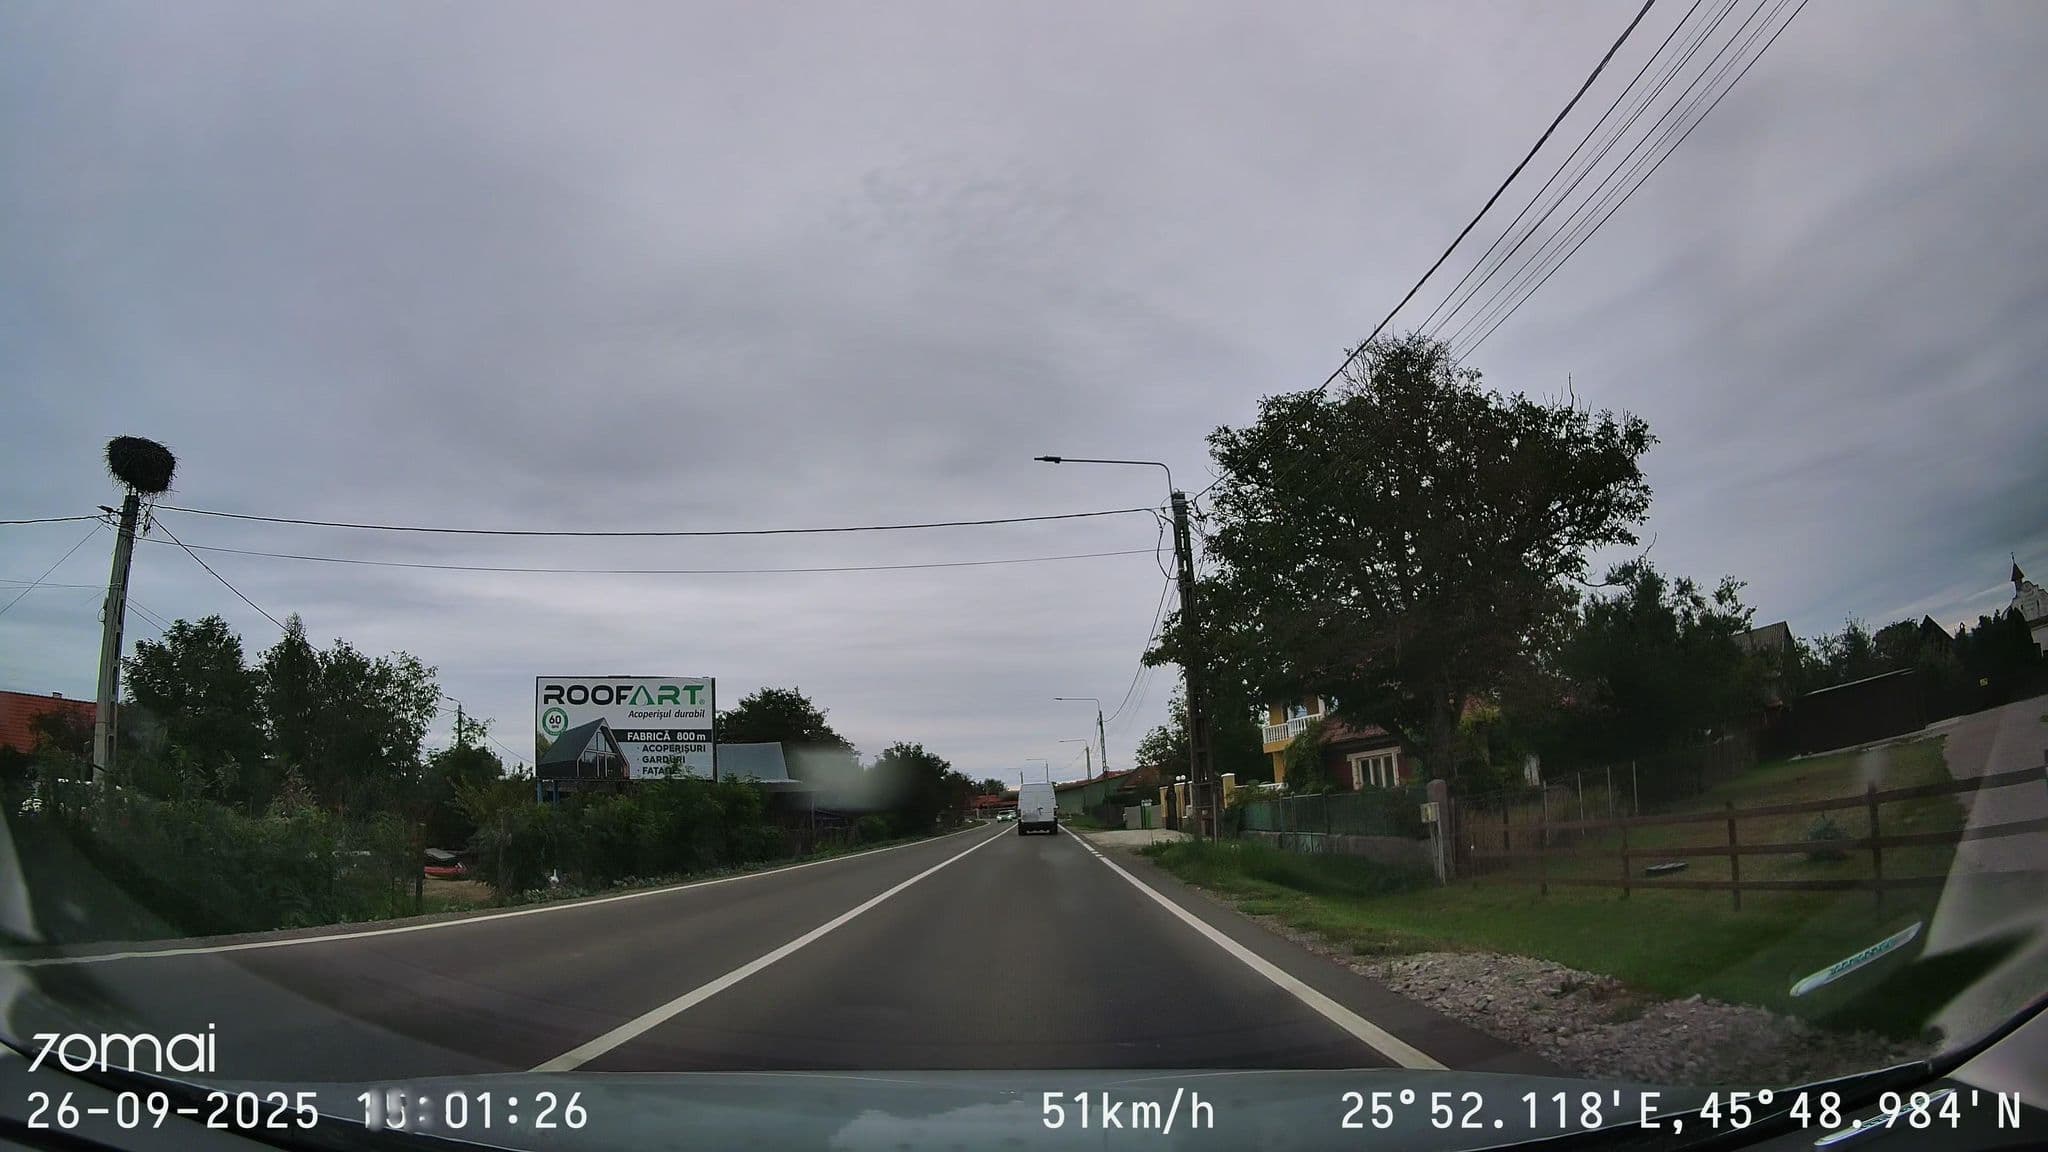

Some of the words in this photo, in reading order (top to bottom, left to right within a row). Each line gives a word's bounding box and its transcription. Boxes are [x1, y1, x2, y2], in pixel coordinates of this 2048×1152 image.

[549, 714, 562, 724] 60
[628, 709, 672, 720] Acoperișul
[674, 709, 705, 718] durabil
[627, 730, 671, 741] FABRICĂ
[676, 732, 695, 741] 800
[642, 744, 706, 754] ACOPERIȘURI
